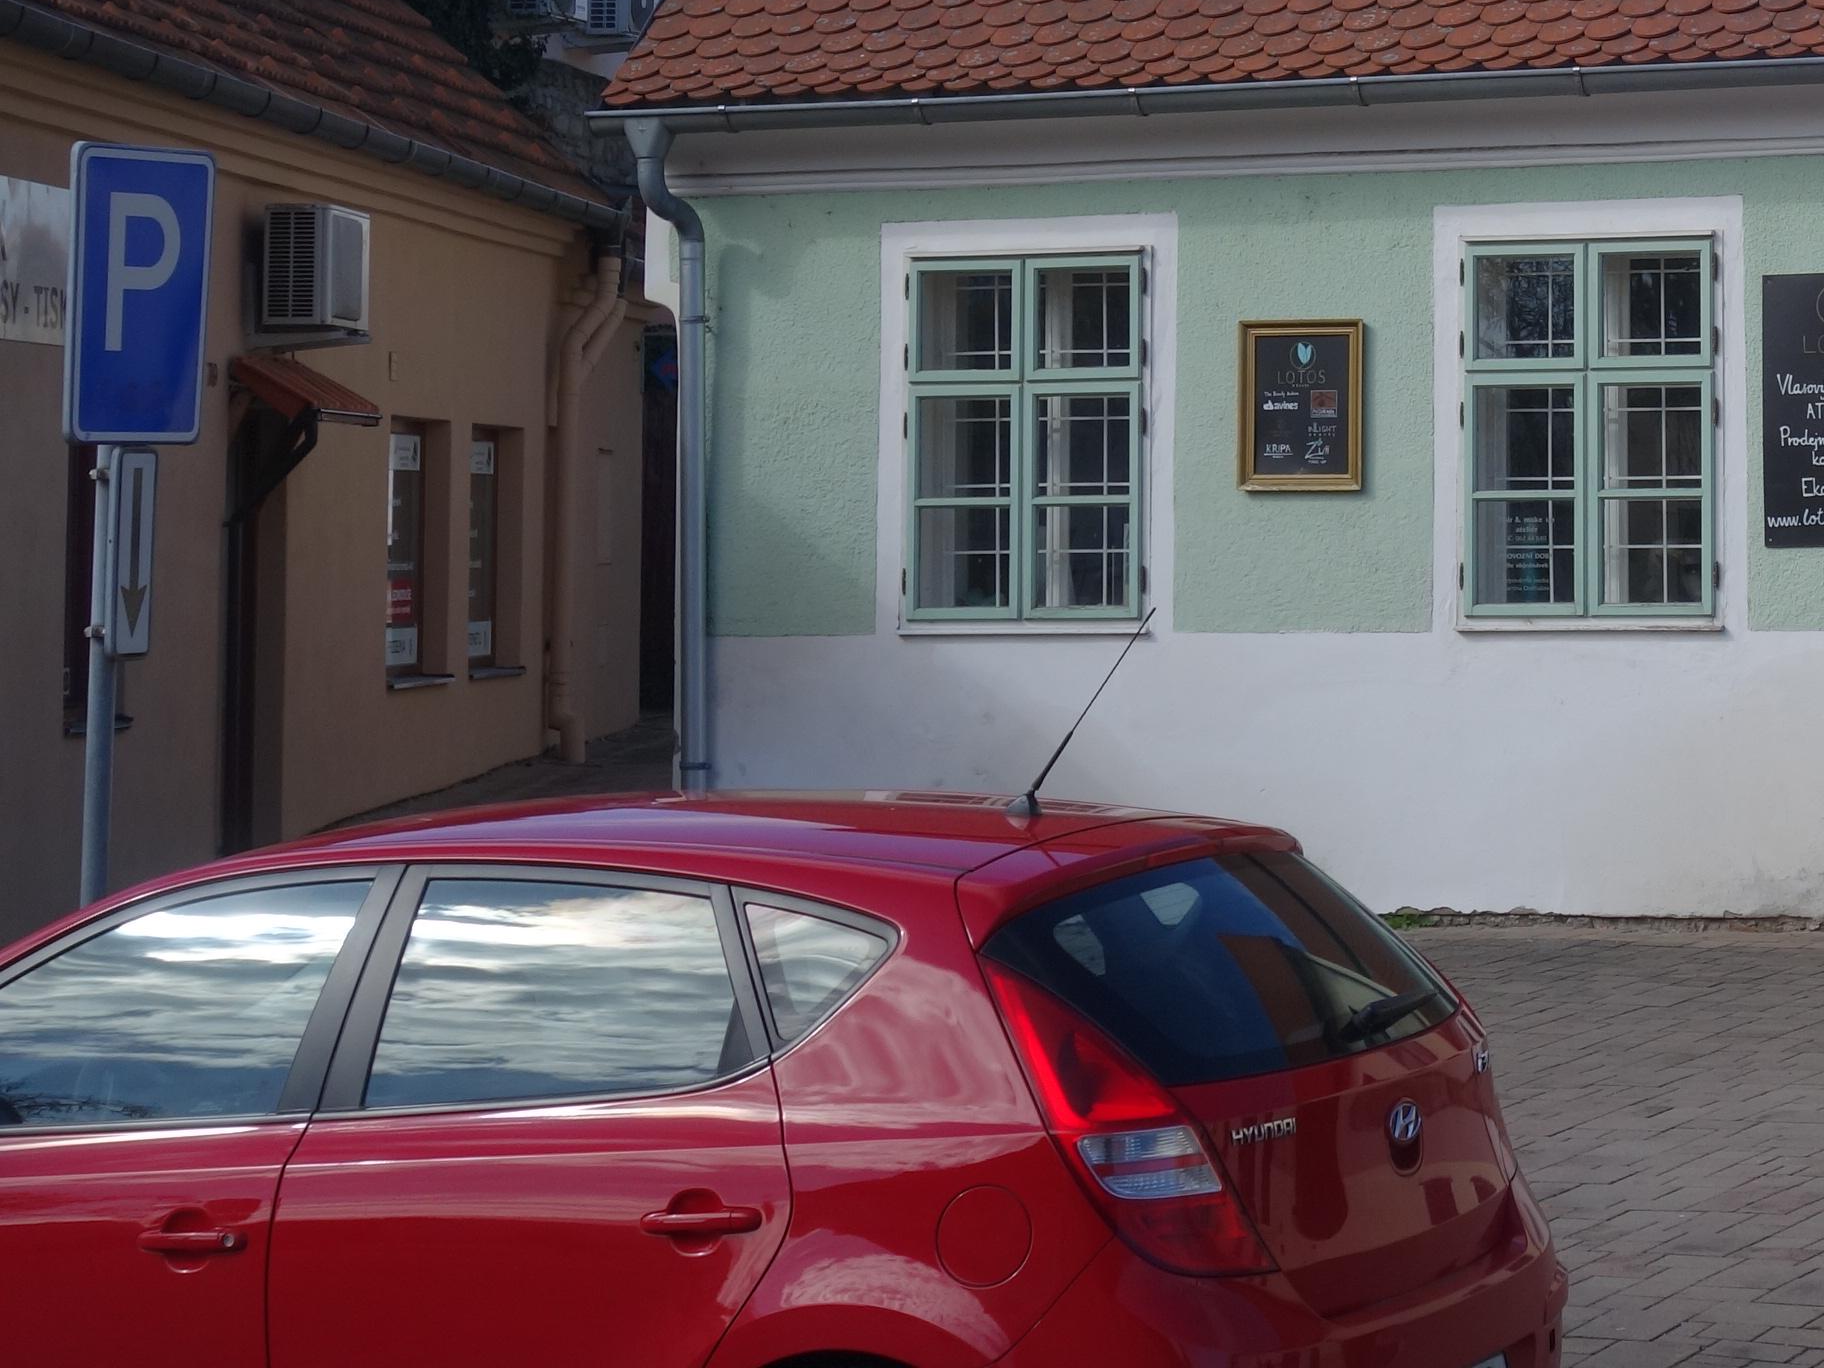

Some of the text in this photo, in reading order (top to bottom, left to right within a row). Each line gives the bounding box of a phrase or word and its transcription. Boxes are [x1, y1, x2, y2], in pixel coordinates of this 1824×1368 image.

[105, 192, 181, 352] P
[1277, 369, 1327, 385] LOTOS
[1231, 1116, 1297, 1145] HYUNDAI
